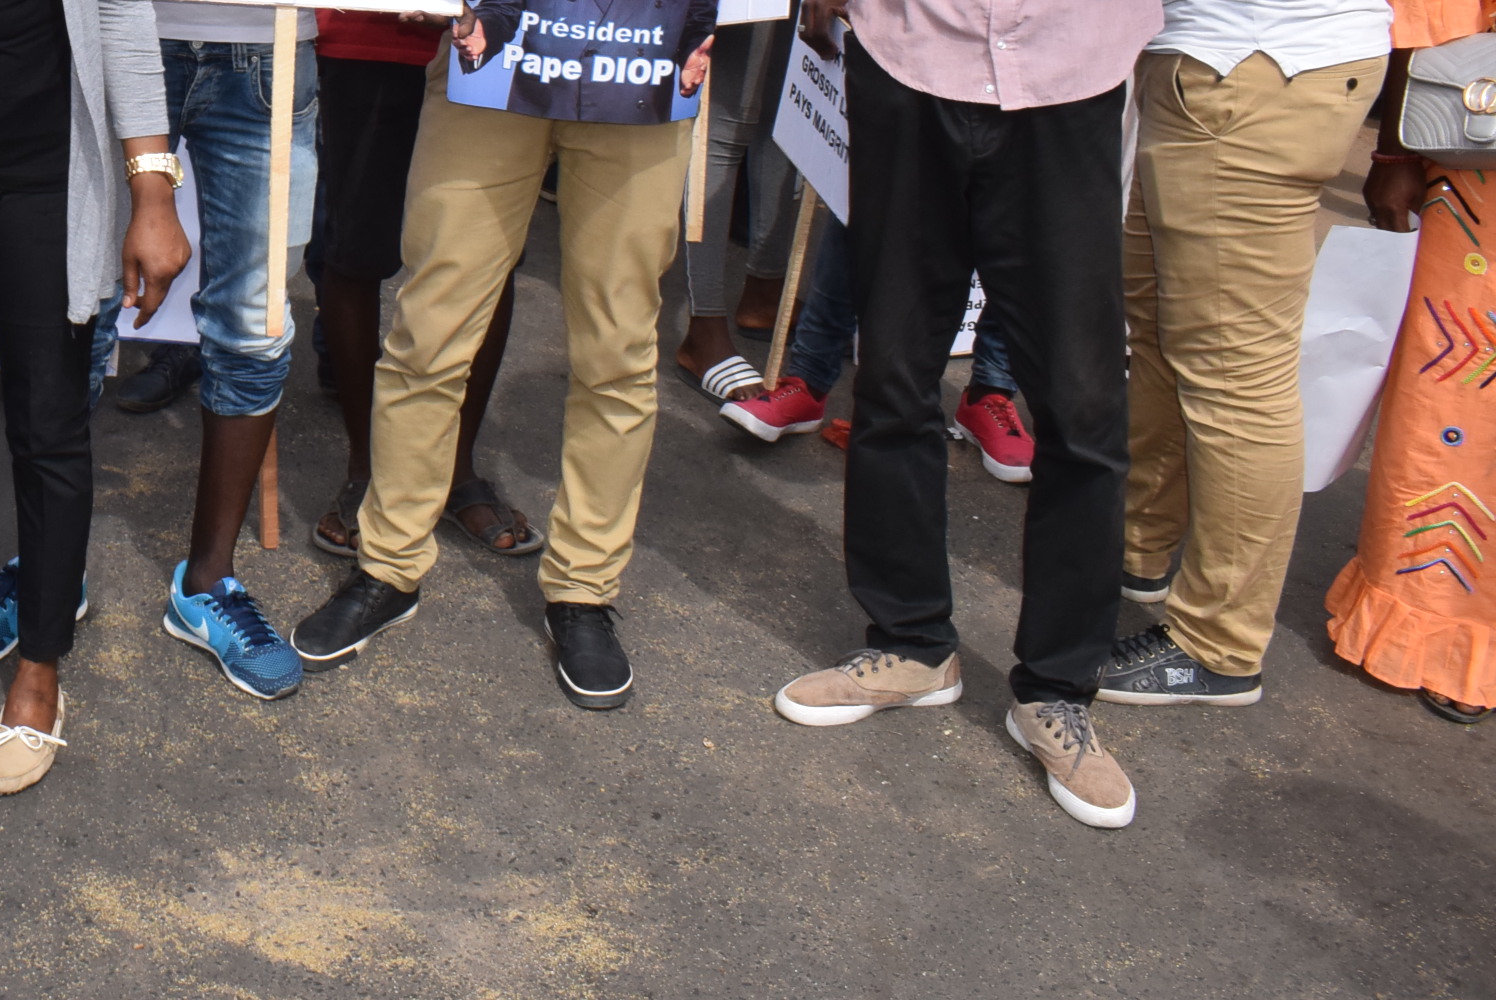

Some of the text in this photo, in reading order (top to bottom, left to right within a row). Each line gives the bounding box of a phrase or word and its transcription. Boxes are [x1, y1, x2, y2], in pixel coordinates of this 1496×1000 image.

[521, 11, 664, 46] Président
[502, 42, 674, 86] Pape DIOP
[802, 54, 838, 106] GROSSIT
[789, 83, 812, 120] PAYS
